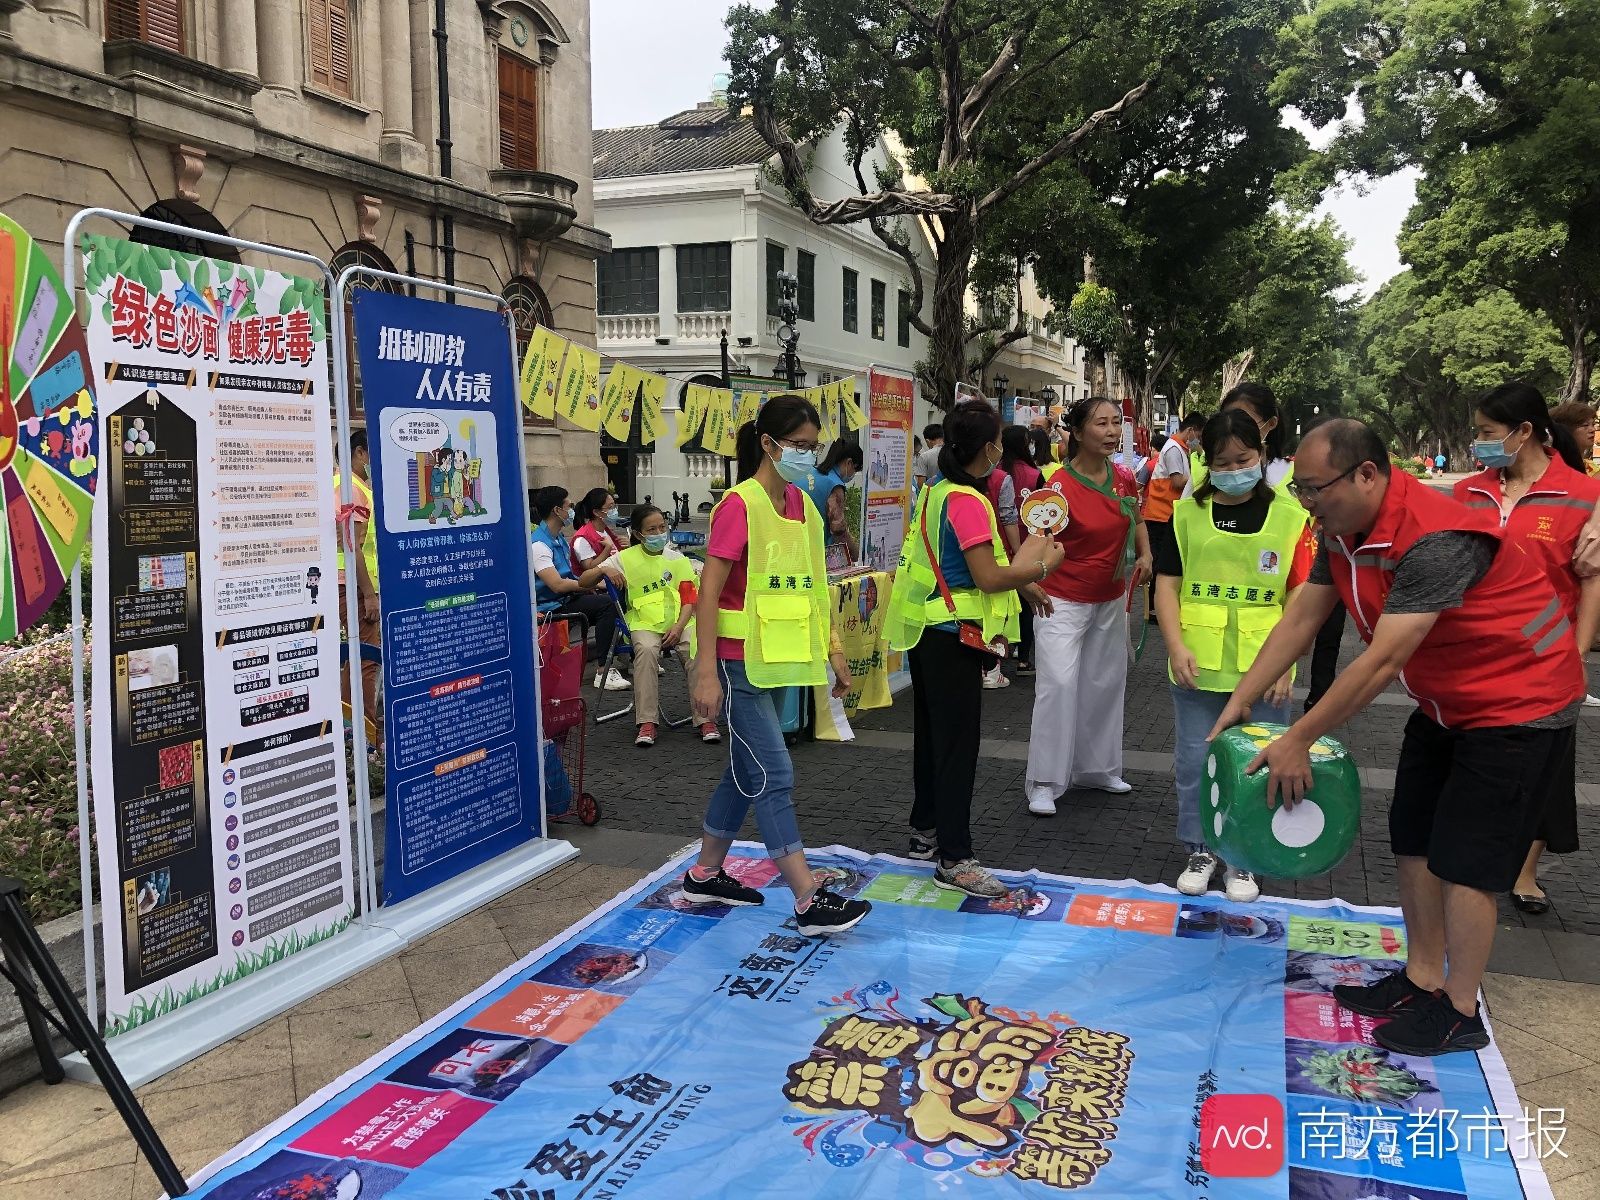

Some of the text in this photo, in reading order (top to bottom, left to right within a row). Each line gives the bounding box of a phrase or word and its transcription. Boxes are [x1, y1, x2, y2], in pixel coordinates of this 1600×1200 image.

[111, 274, 220, 361] 绿色沙面
[228, 310, 315, 365] 健康无毒
[377, 325, 466, 367] 抵制邪教
[122, 367, 185, 382] 认识这些新型毒品
[415, 368, 491, 403] 人人有责
[1215, 520, 1237, 528] THE
[769, 574, 813, 590] 荔湾志
[1191, 583, 1276, 602] 荔湾志愿者
[1305, 923, 1335, 946] 出发
[1343, 929, 1371, 949] GO
[340, 1097, 413, 1148] 为禁毒工作
[1006, 1026, 1135, 1190] 等你来挑战
[389, 1107, 451, 1151] 直接通关
